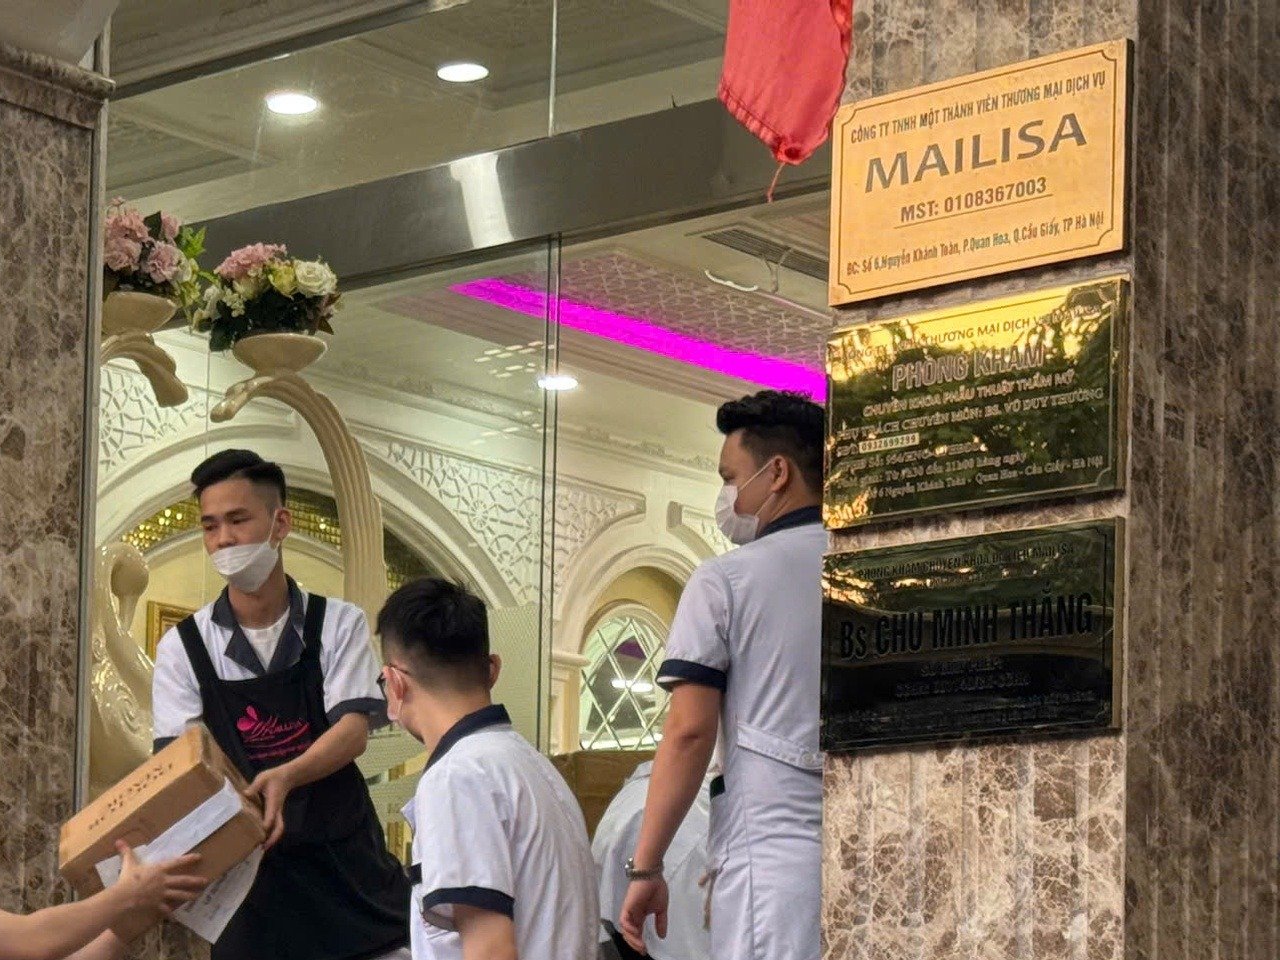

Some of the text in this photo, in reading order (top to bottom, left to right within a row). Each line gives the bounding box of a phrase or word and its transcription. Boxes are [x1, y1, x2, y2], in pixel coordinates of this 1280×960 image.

[851, 70, 1106, 144] CÔNG TY TNHH MỘT THÀNH VIÊN THƯƠNG MẠI DỊCH VỤ
[865, 112, 1088, 194] MAILISA
[901, 176, 1047, 222] MST: 0108367003
[1062, 217, 1073, 232] TP
[1075, 214, 1087, 230] Hà
[977, 323, 1001, 338] MẠI
[1002, 317, 1030, 333] DỊCH
[892, 330, 1045, 393] PHÒNG KHÁM
[840, 620, 866, 660] Bs
[875, 611, 923, 656] CHU
[932, 604, 999, 650] MINH
